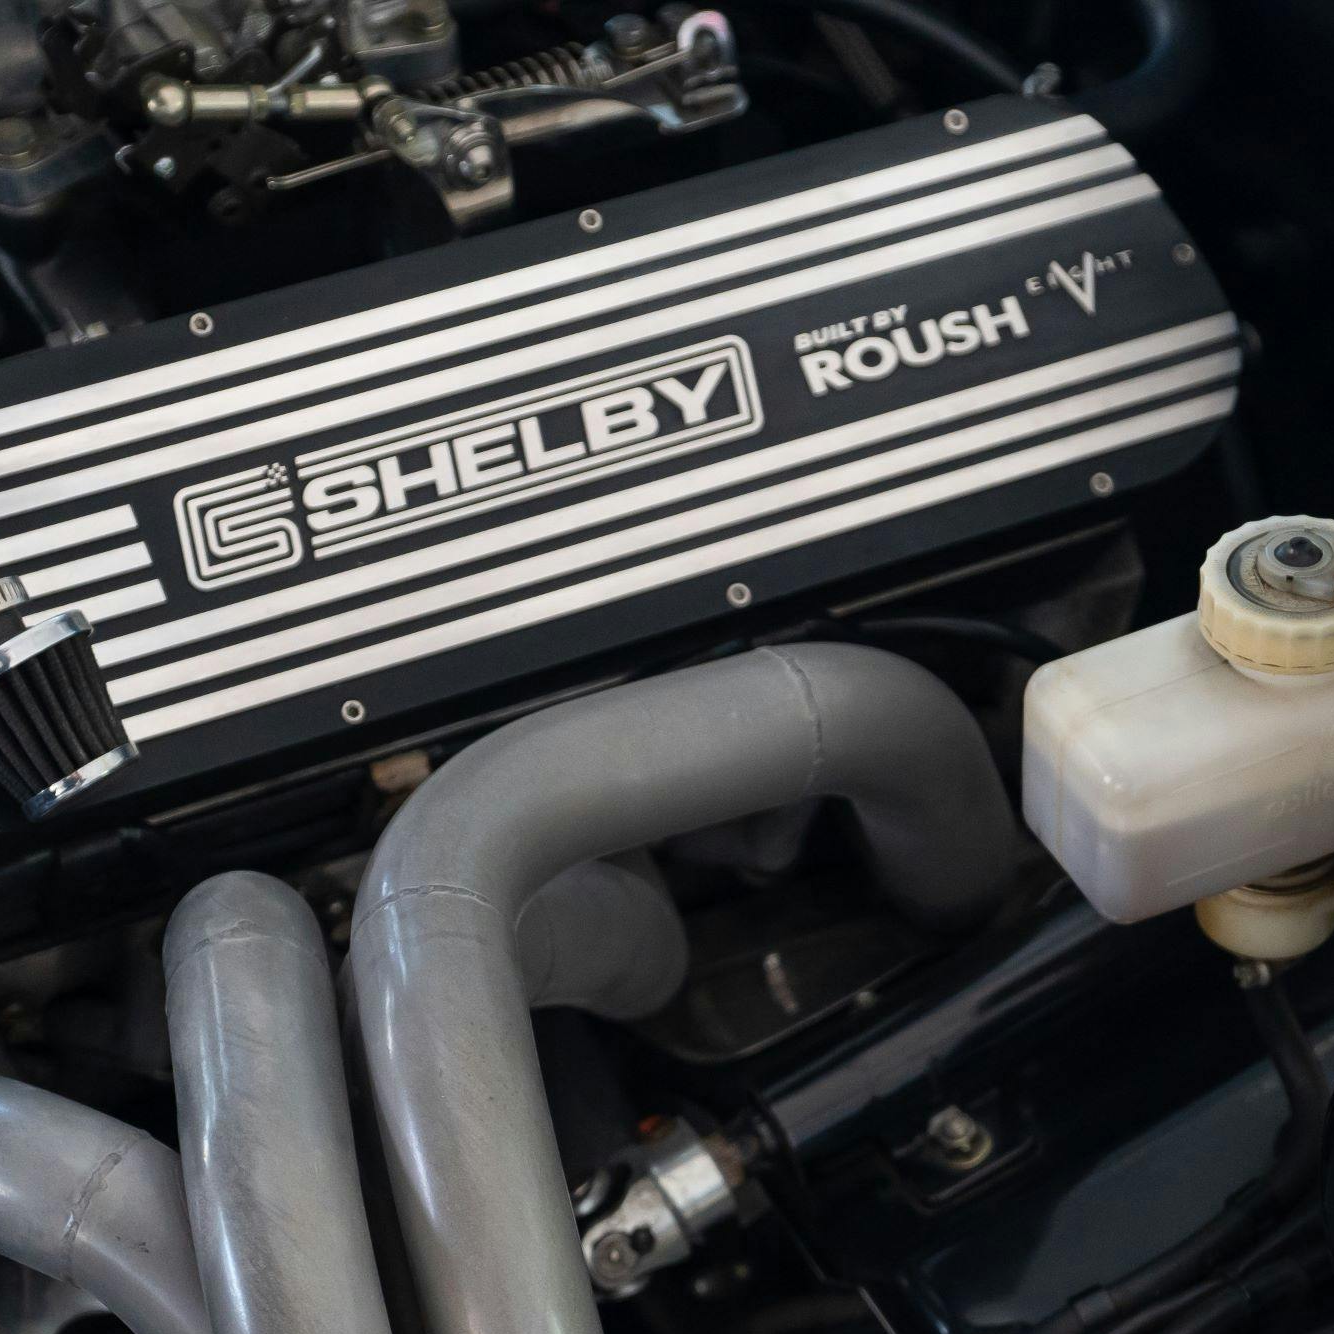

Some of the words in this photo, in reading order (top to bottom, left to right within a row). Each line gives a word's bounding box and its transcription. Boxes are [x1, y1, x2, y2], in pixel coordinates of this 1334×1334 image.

[793, 315, 869, 354] BUILT
[870, 303, 909, 332] BY
[799, 294, 1031, 398] ROUSH
[301, 361, 729, 533] SHELBY
